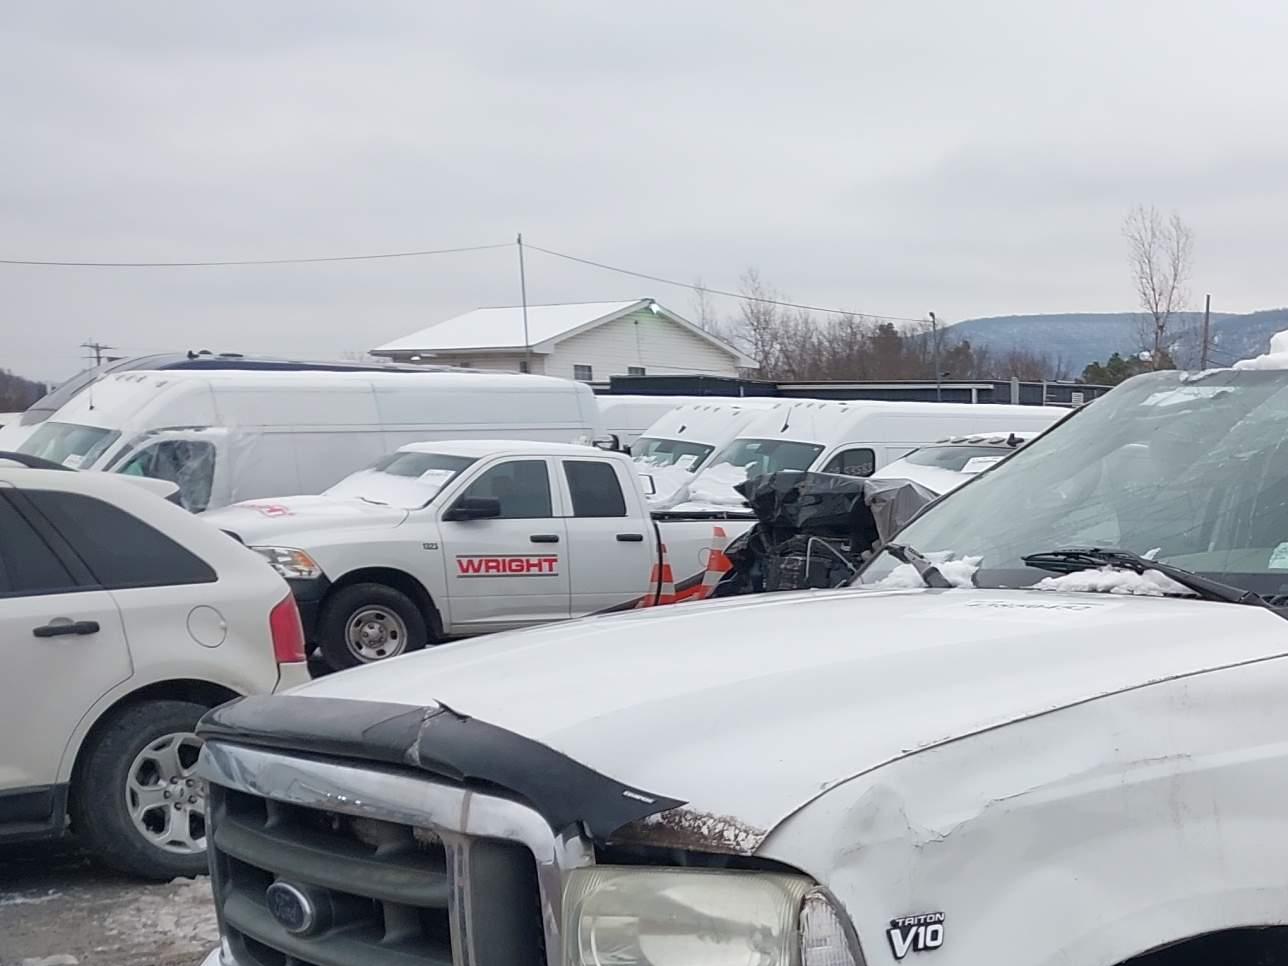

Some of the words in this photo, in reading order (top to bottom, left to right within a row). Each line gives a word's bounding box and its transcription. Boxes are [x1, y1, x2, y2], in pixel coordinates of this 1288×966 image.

[457, 558, 559, 574] WRIGHT
[895, 912, 945, 927] TRITON
[889, 924, 944, 958] V10
